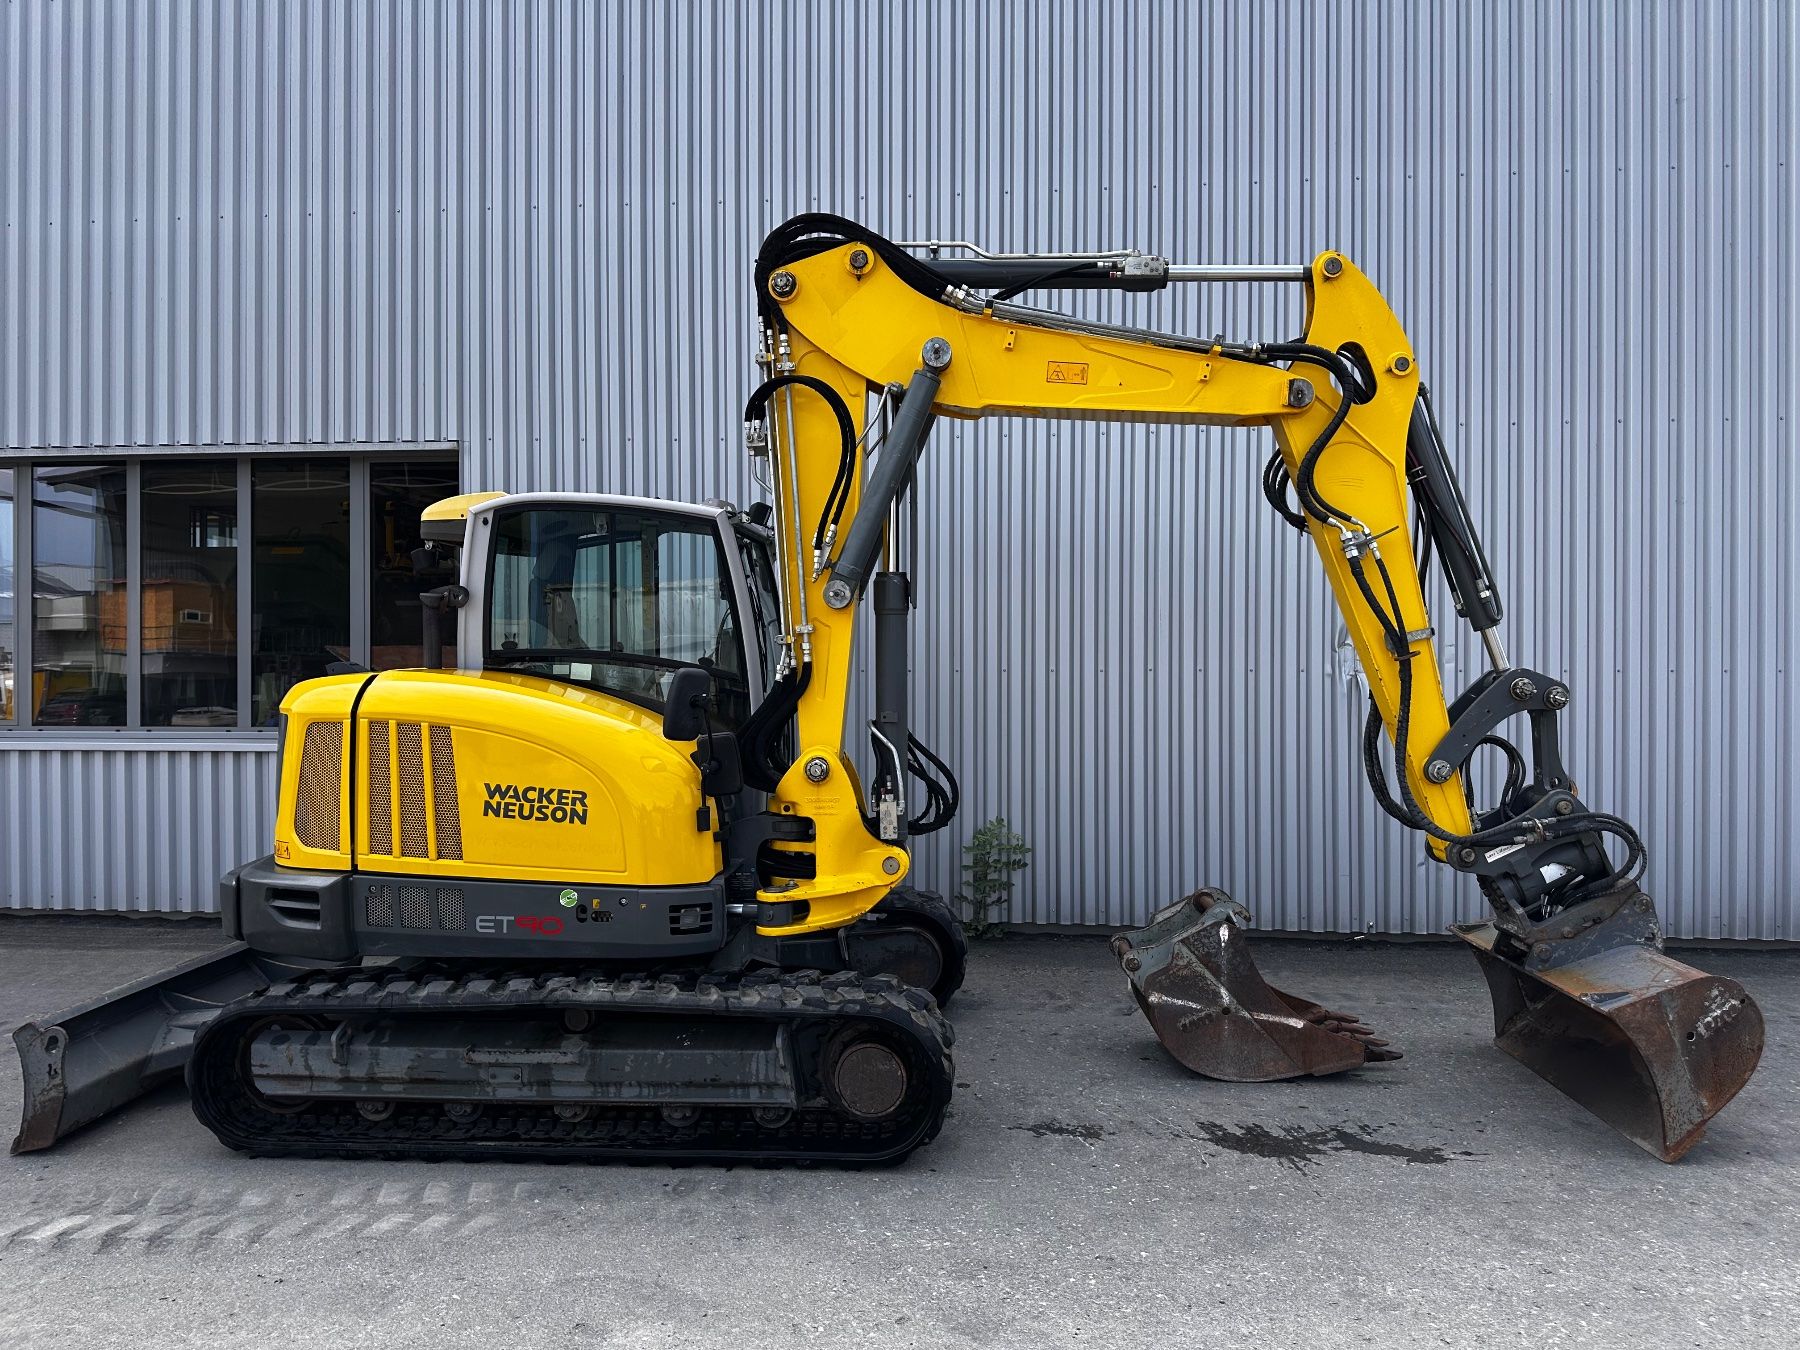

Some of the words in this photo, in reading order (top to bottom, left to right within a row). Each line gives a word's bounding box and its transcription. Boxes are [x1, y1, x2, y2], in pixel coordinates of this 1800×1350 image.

[484, 782, 588, 808] WACKER
[483, 800, 588, 825] NEUSON
[475, 915, 565, 936] ET90
